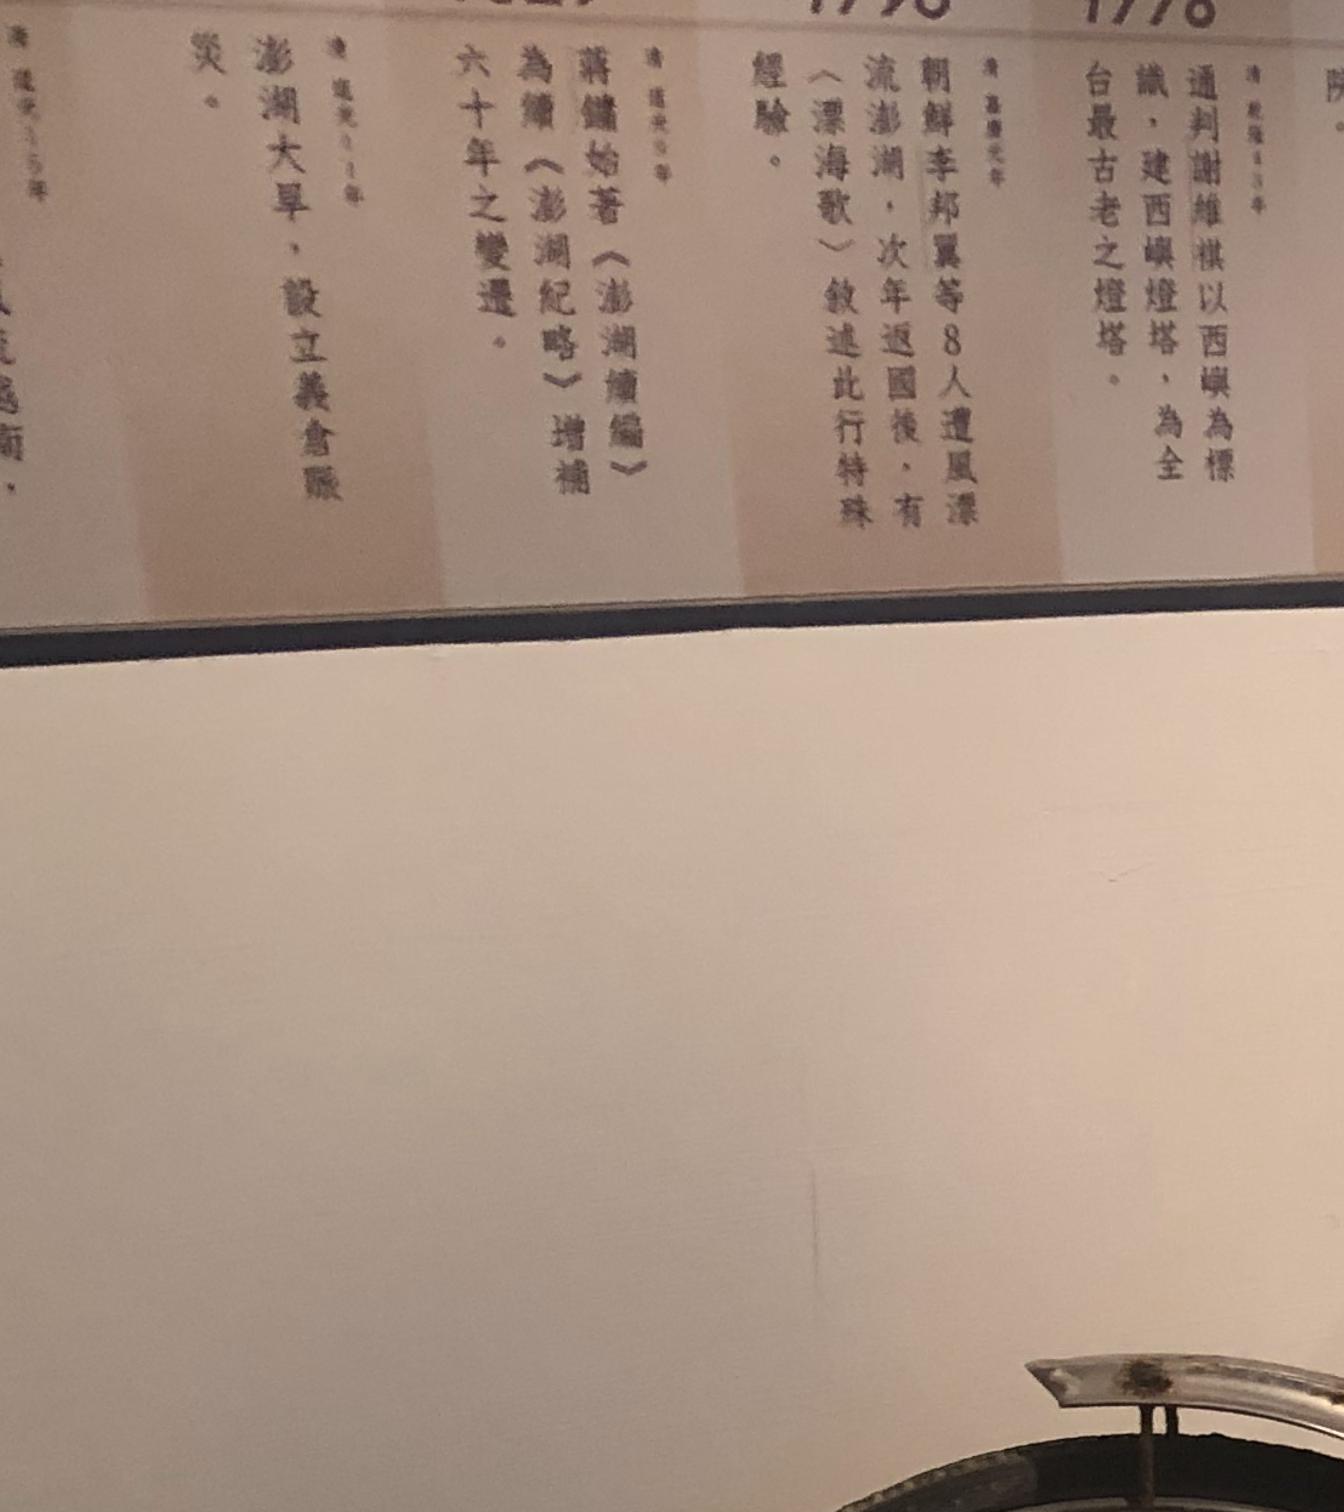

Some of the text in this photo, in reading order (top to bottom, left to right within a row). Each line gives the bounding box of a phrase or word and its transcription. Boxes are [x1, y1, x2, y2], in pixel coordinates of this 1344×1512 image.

[751, 49, 792, 168] 經驗。
[1085, 61, 1128, 386] 台最古老之燈塔。
